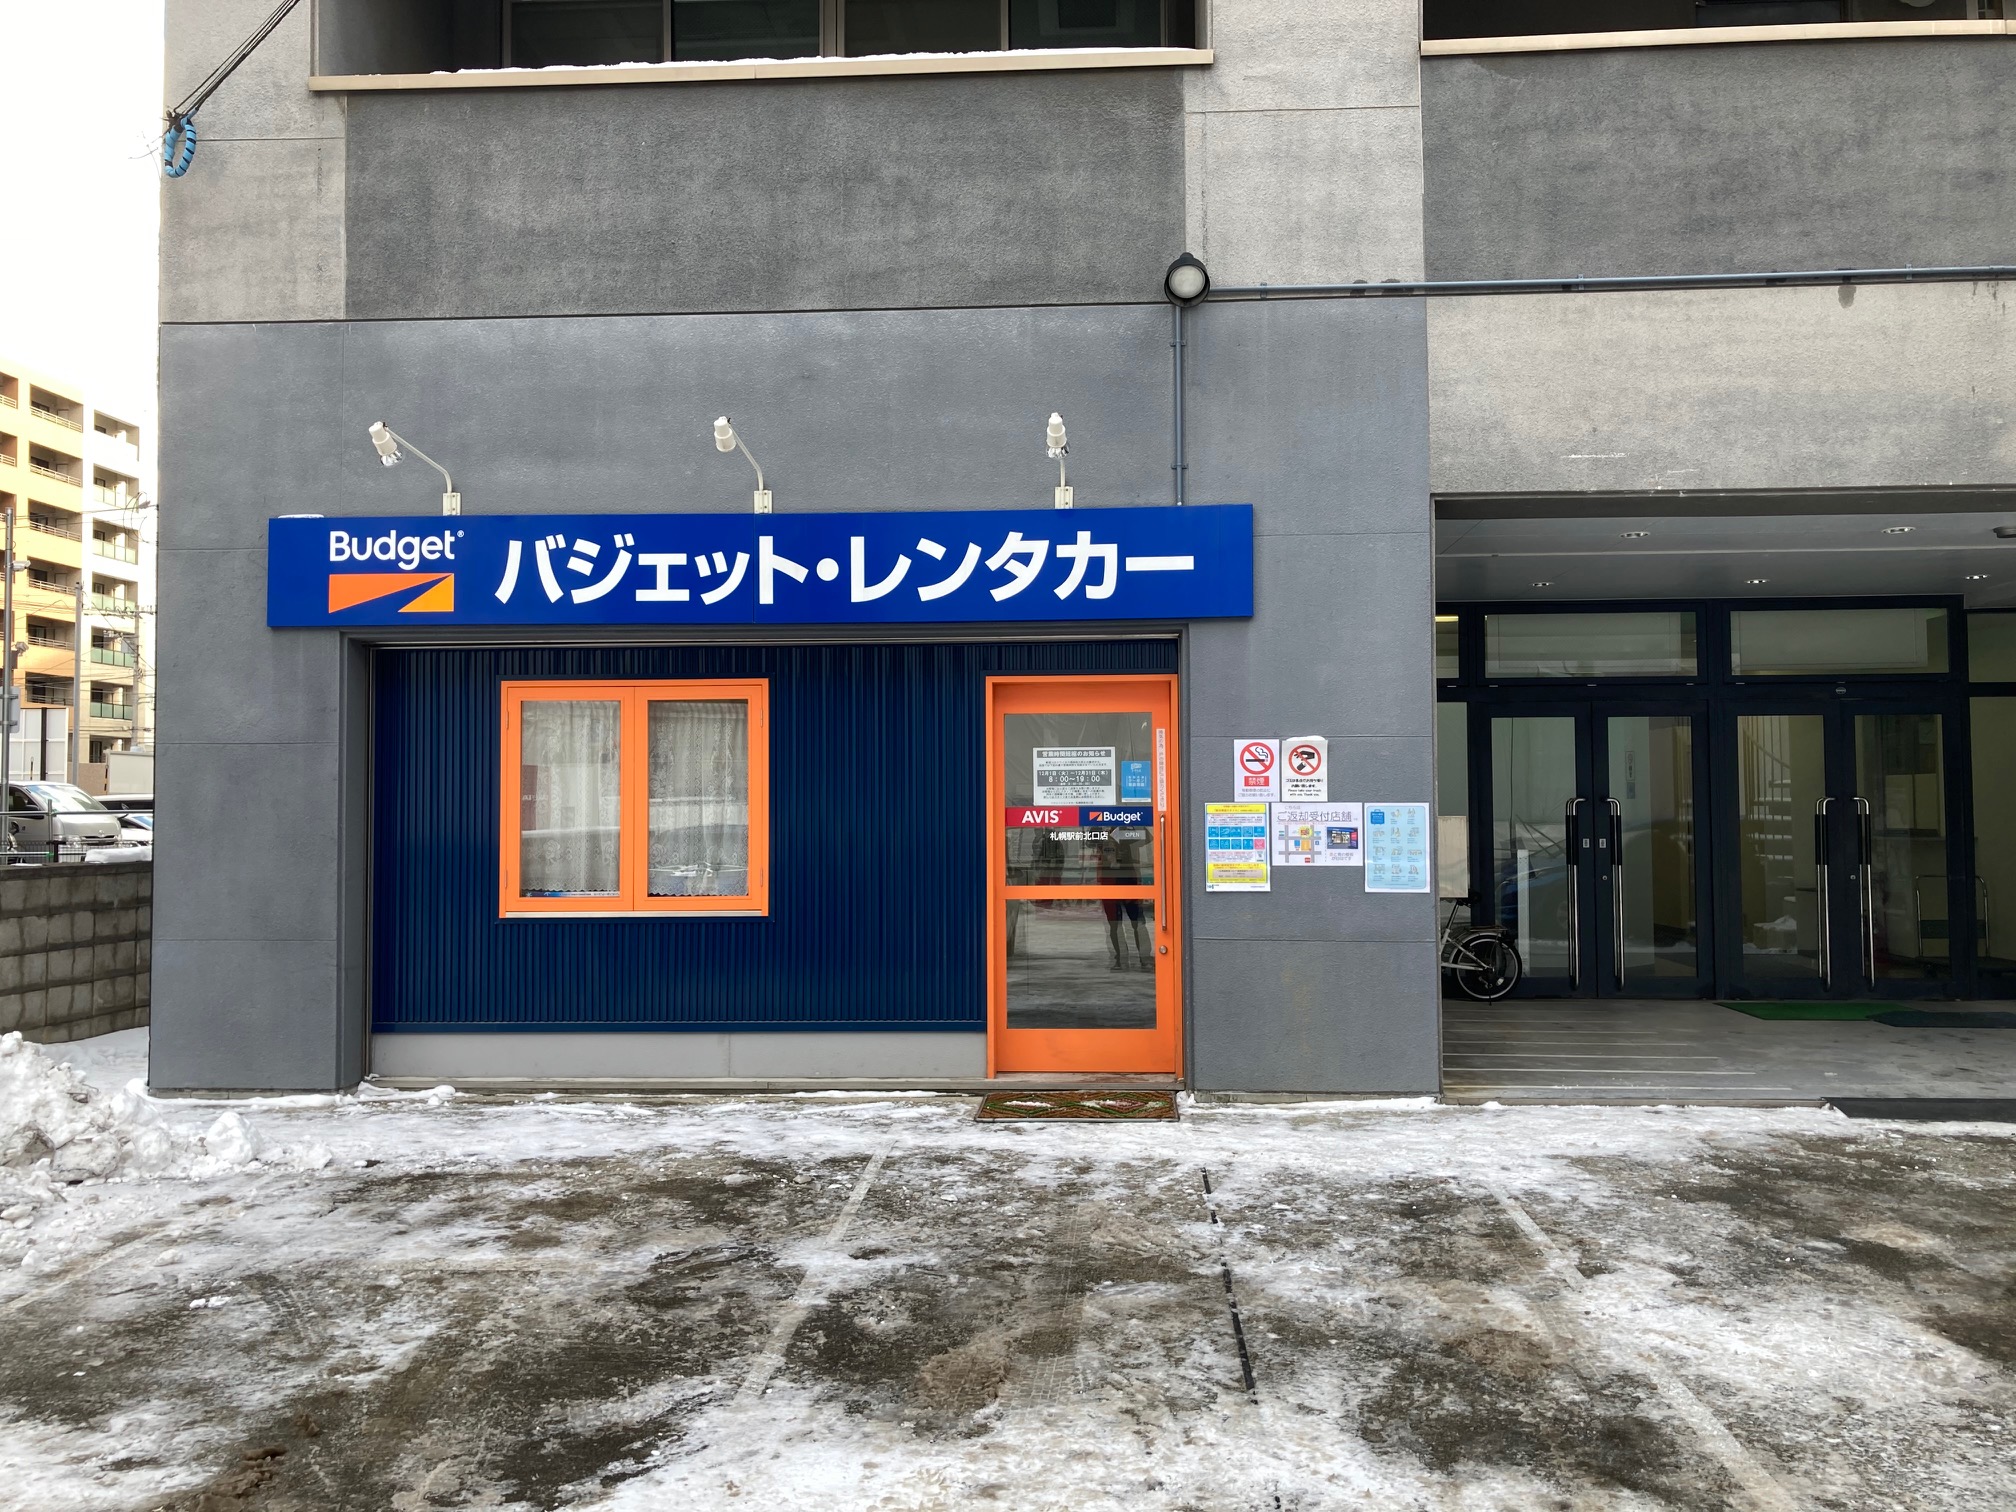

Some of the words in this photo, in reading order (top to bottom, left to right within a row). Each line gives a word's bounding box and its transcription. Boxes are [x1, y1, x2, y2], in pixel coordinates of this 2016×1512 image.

[329, 530, 456, 571] Budget
[494, 530, 1195, 605] バジェット・レンタカー
[1248, 777, 1265, 786] 禁煙
[1021, 810, 1060, 824] AVIS
[1104, 811, 1141, 824] Budget
[1277, 811, 1352, 822] ご返却受付店舗
[1050, 831, 1109, 841] 札幌駅前北口店
